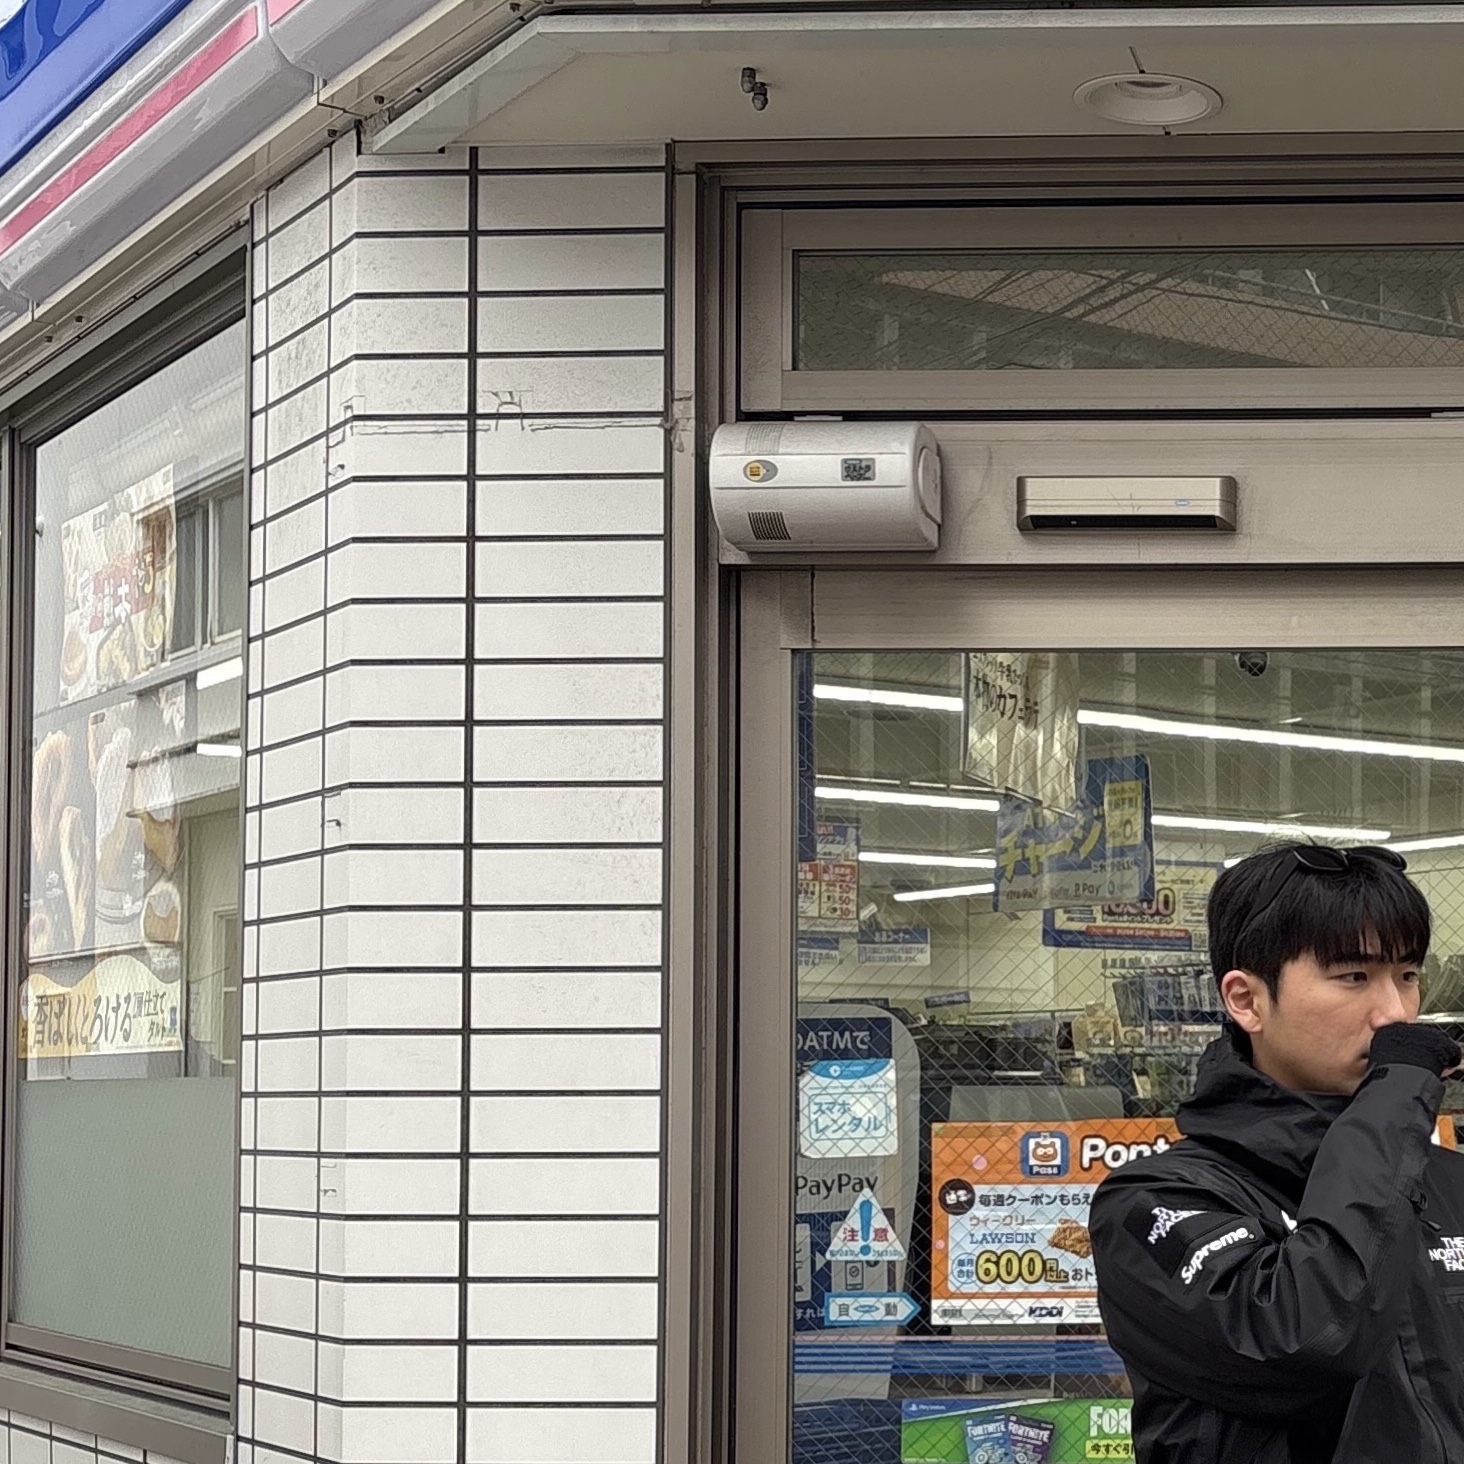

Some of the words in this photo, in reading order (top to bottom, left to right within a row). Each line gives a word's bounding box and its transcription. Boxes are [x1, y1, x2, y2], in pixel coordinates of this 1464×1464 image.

[812, 1100, 851, 1115] スマホ
[813, 1115, 883, 1135] レンタル
[1033, 1164, 1059, 1176] Pass
[969, 1214, 1036, 1227] ウィークリー
[969, 1233, 1036, 1245] LAWSON
[1181, 1227, 1248, 1284] Supreme
[976, 1250, 1044, 1285] 600
[838, 1302, 898, 1317] 自動
[967, 1421, 1006, 1438] FORTNITE
[1008, 1421, 1051, 1442] FORTNITE
